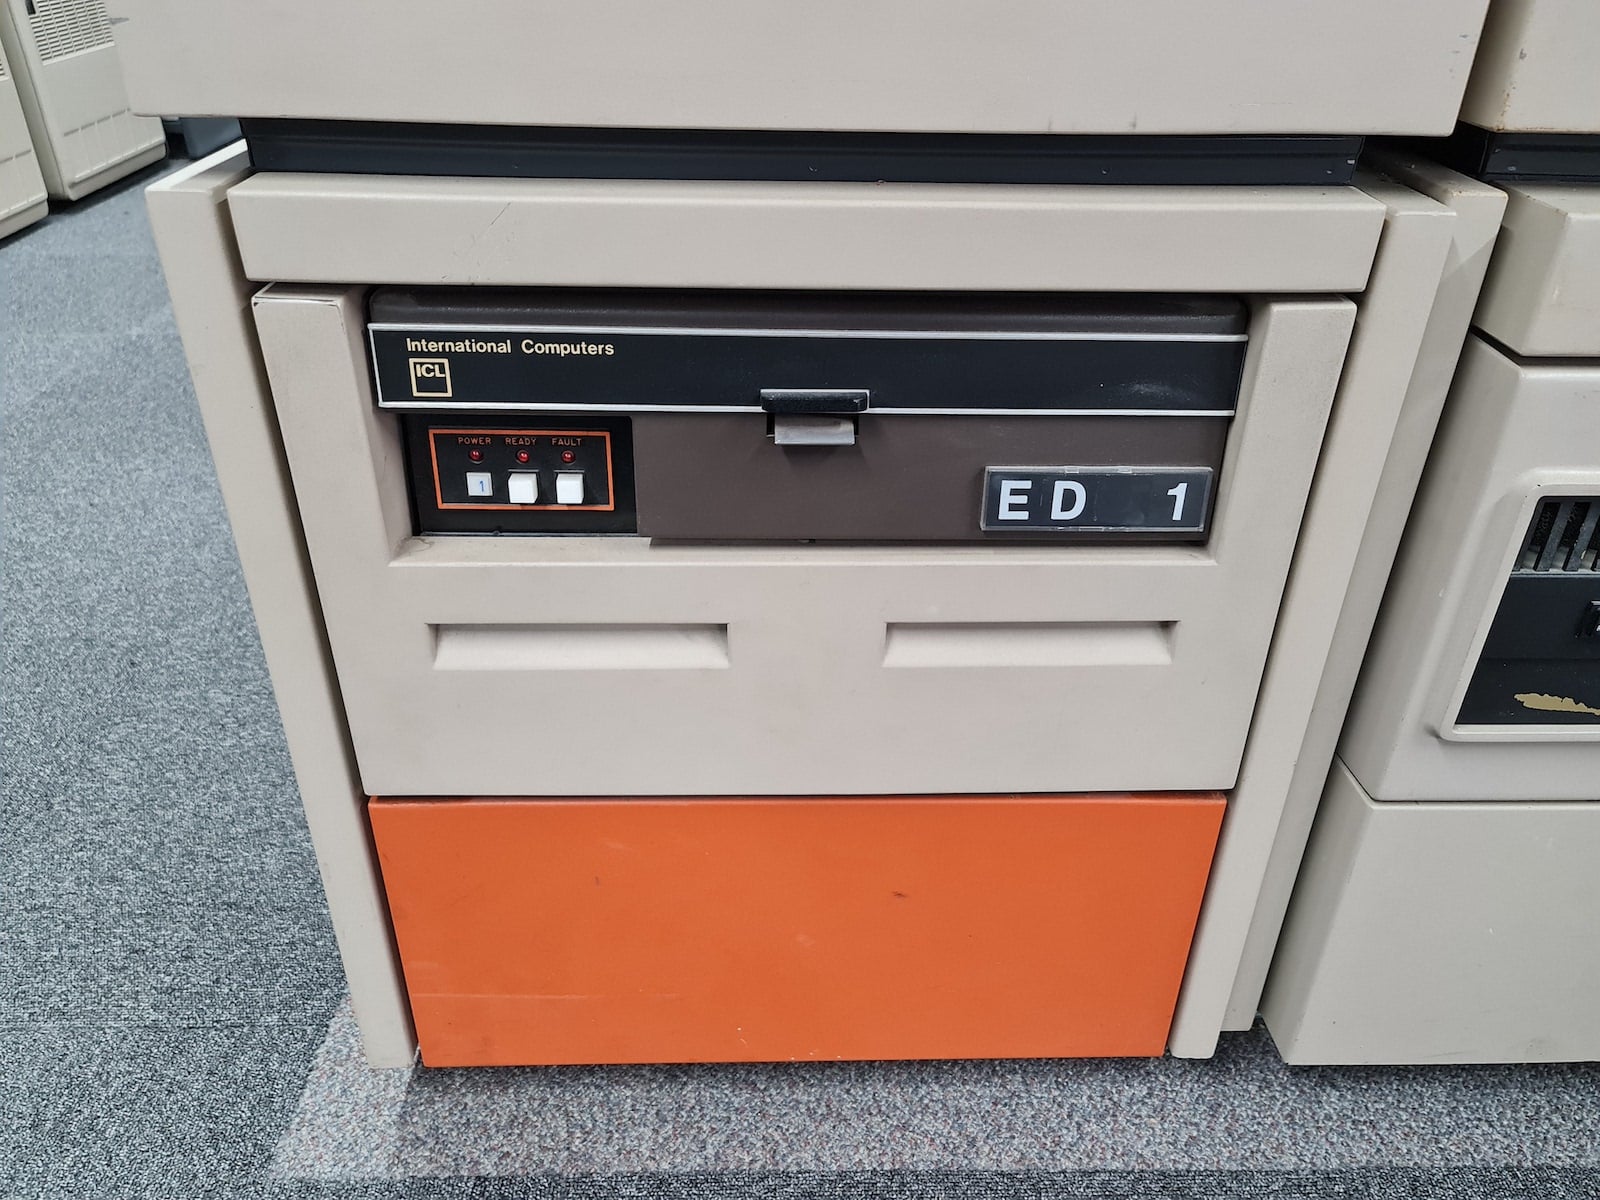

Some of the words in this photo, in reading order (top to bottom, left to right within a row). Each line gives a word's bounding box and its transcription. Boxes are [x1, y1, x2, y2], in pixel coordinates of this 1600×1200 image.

[406, 337, 512, 354] International
[521, 339, 615, 357] Computers
[415, 363, 446, 377] ICL
[457, 437, 492, 445] POWER
[505, 438, 537, 446] READY
[551, 438, 582, 446] FAULT
[1166, 482, 1188, 521] 1
